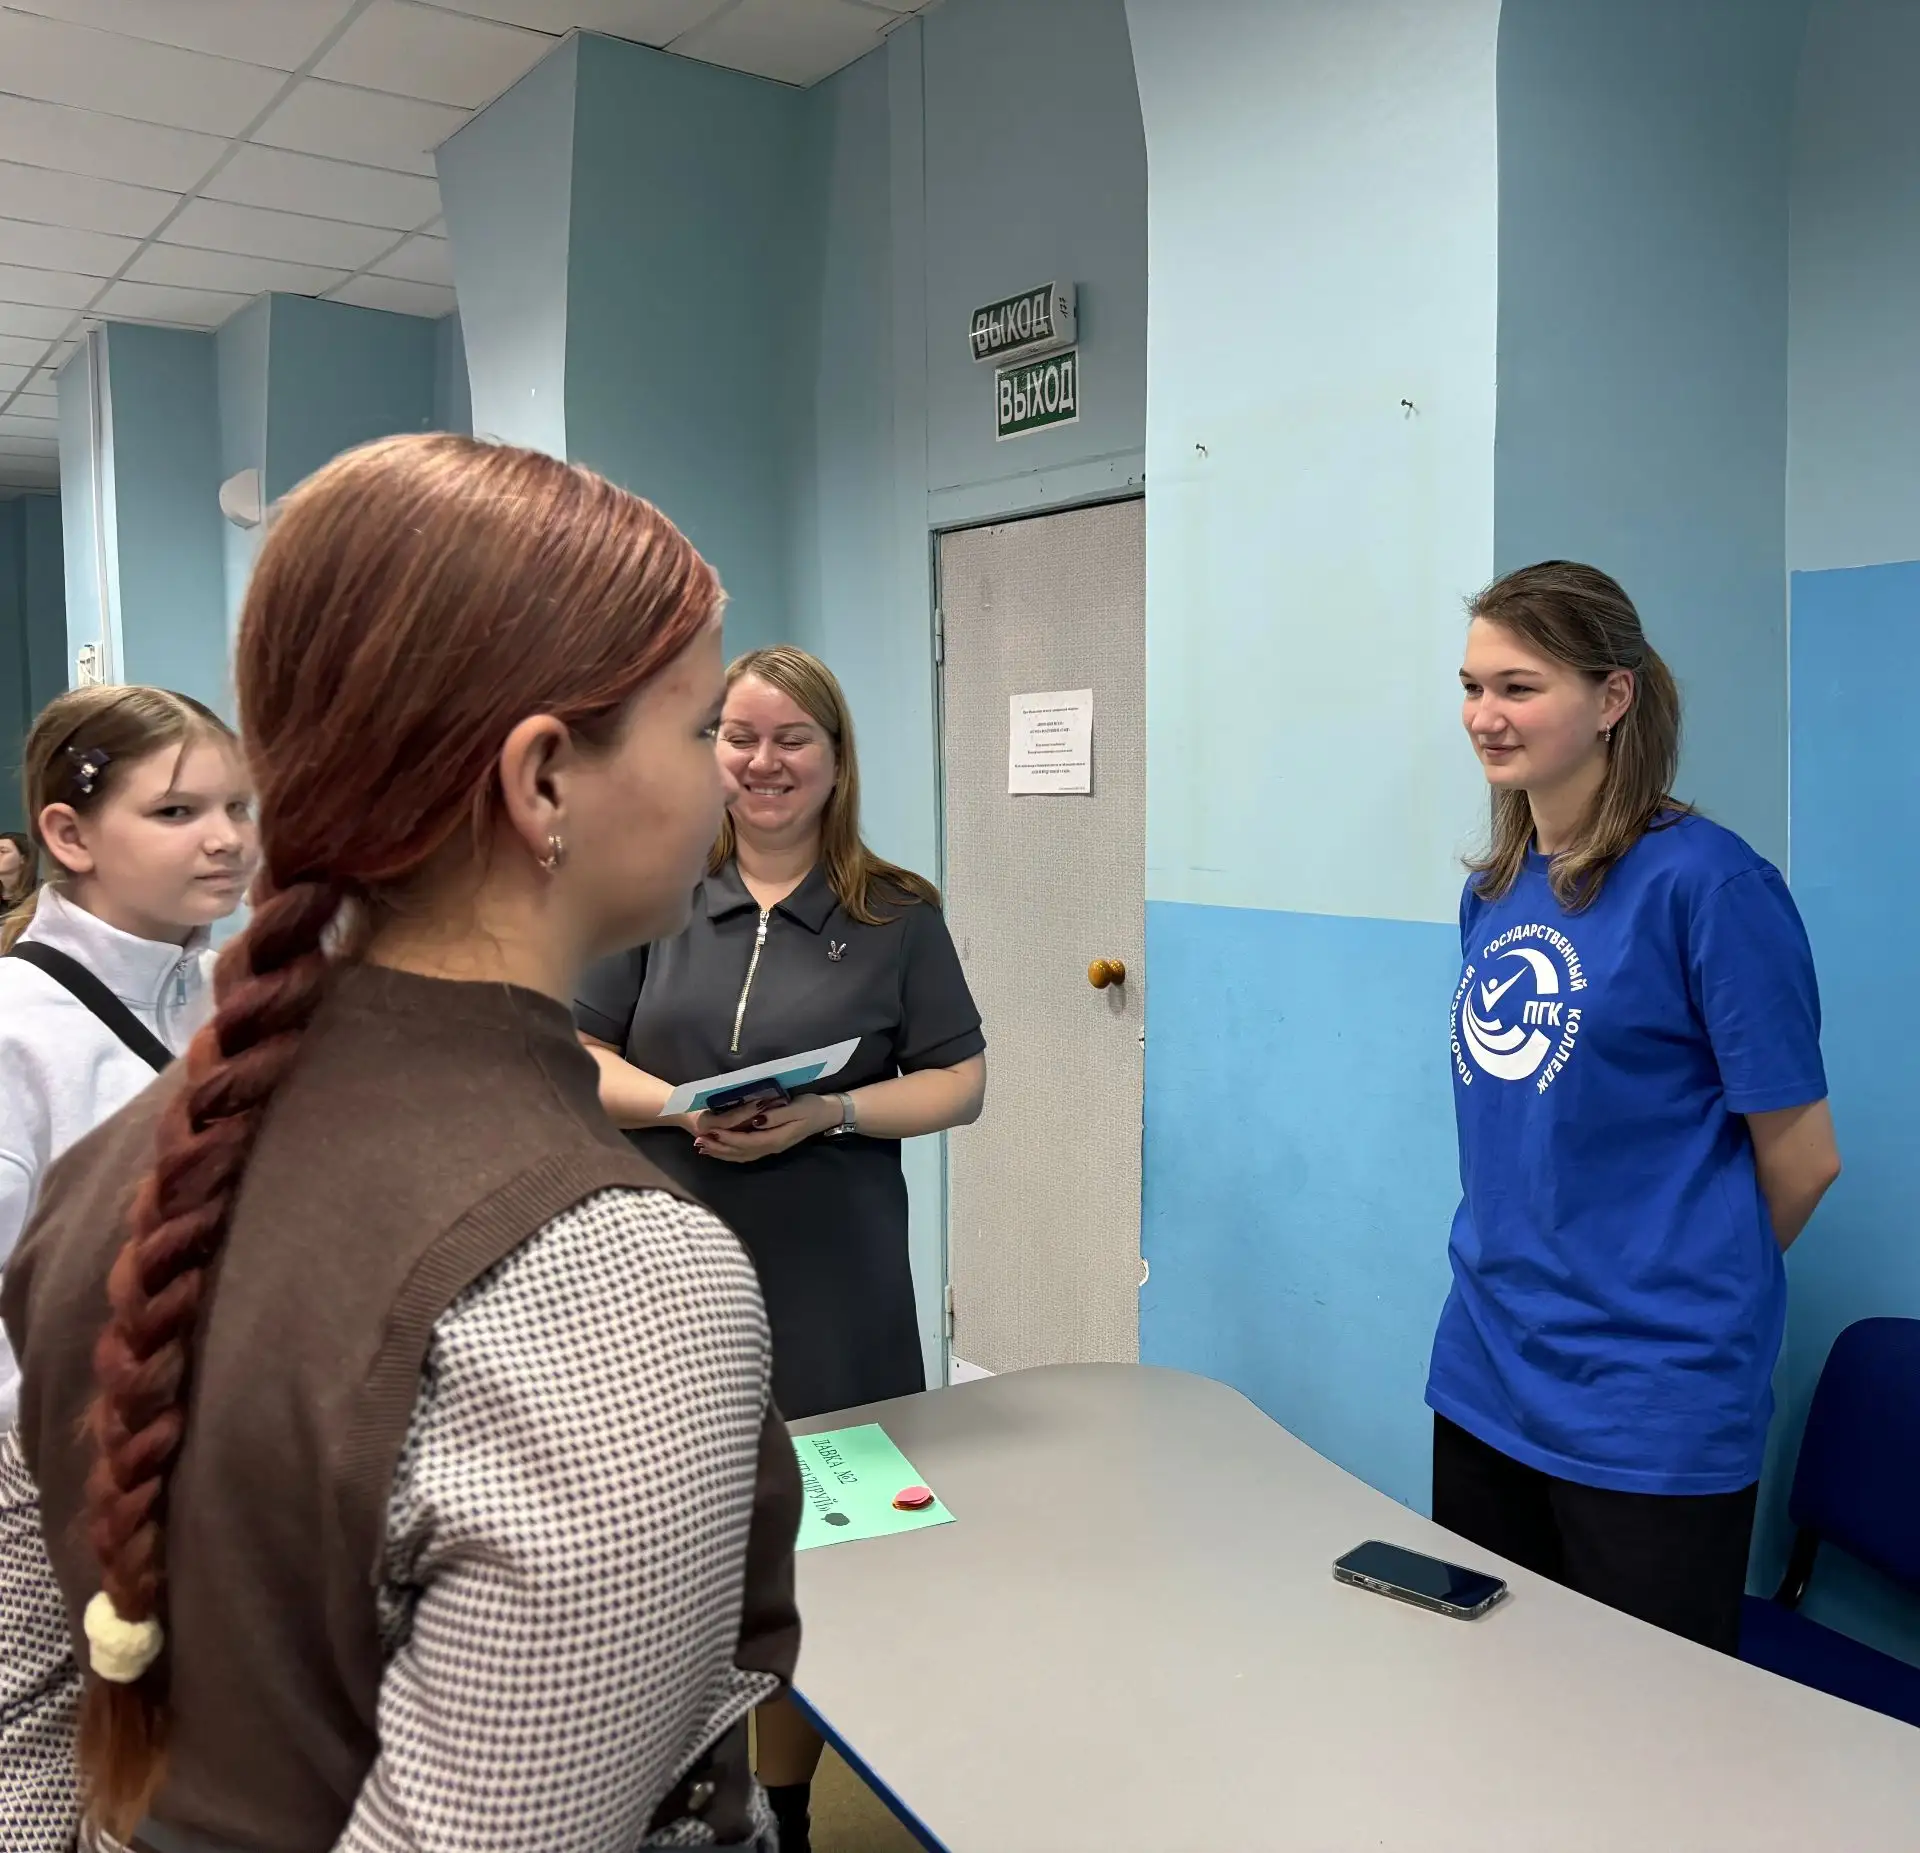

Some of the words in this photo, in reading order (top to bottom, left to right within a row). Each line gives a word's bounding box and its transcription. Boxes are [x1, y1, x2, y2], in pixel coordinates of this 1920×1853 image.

[976, 293, 1049, 352] ВЫХОД
[1000, 361, 1074, 425] ВЫХОД
[1450, 964, 1476, 1086] ПОВОЛЖСКИЙ
[1483, 923, 1588, 992] ГОСУДАРСТВЕННЫЙ
[1536, 1008, 1582, 1095] КОЛЛЕДЖ
[1523, 1000, 1564, 1027] ПГК
[811, 1439, 845, 1469] ЛАВКА
[834, 1470, 858, 1485] №2
